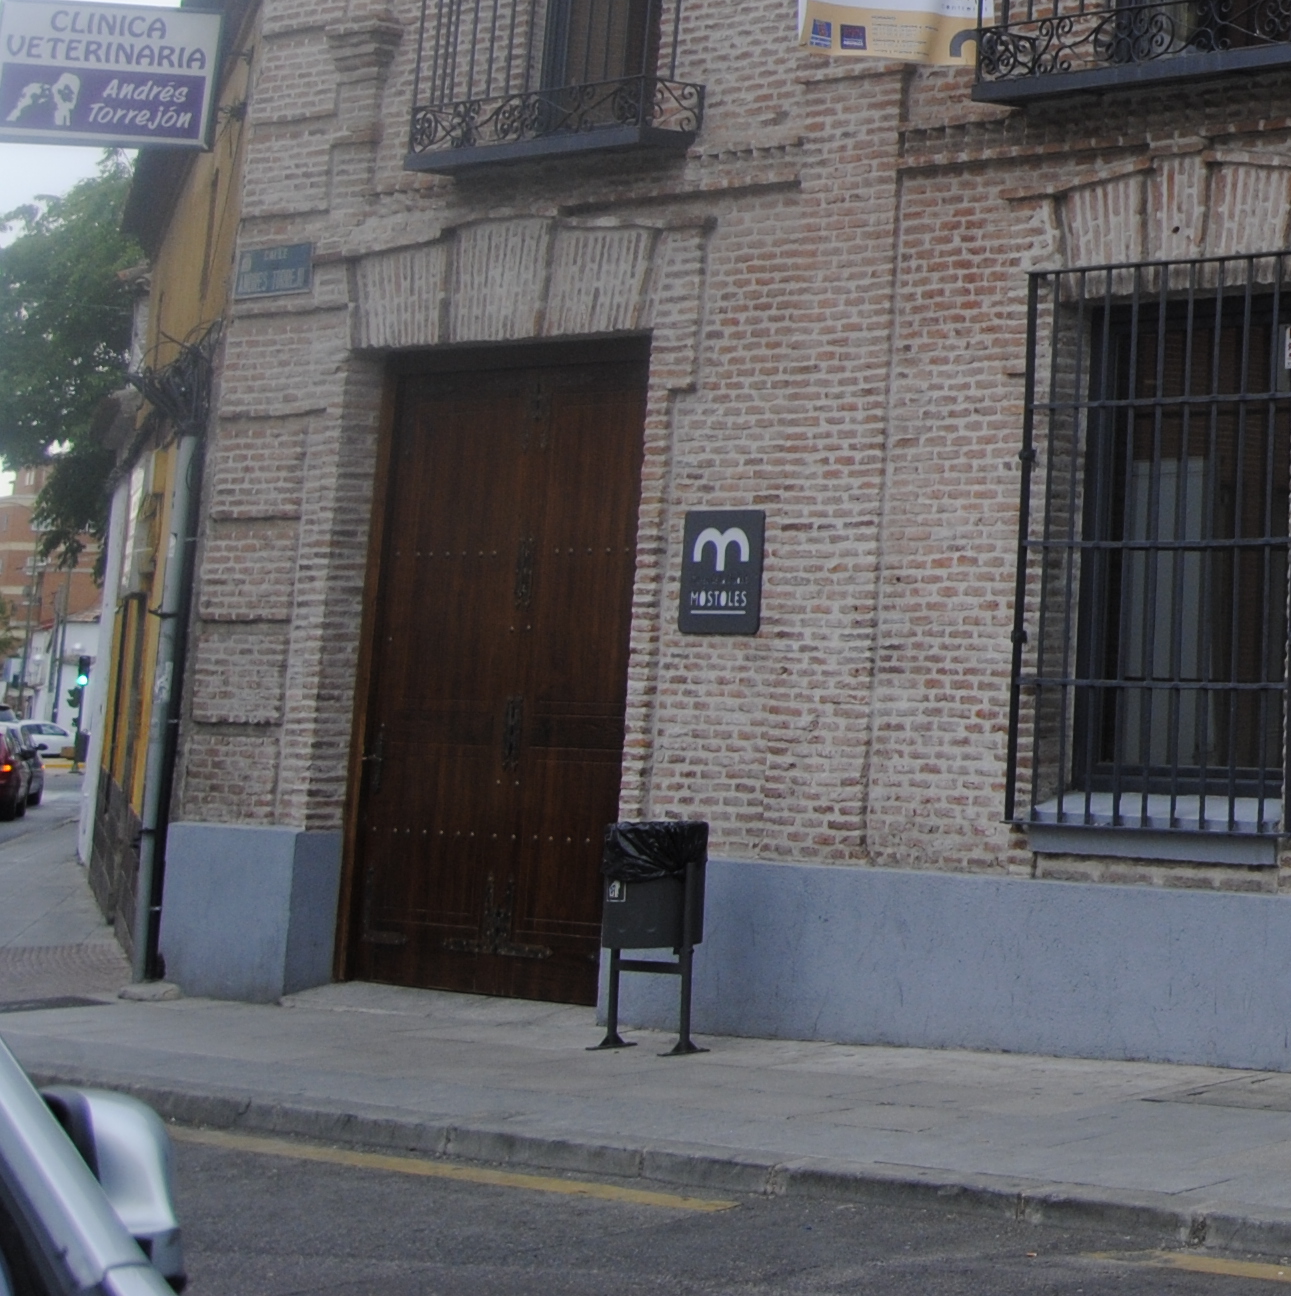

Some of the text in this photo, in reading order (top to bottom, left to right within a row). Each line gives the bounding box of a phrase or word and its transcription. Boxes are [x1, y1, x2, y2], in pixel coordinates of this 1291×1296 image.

[50, 9, 167, 40] CLINICA
[6, 33, 207, 70] VETERINARIA
[102, 78, 189, 104] Andrés
[88, 103, 192, 130] Torrejón
